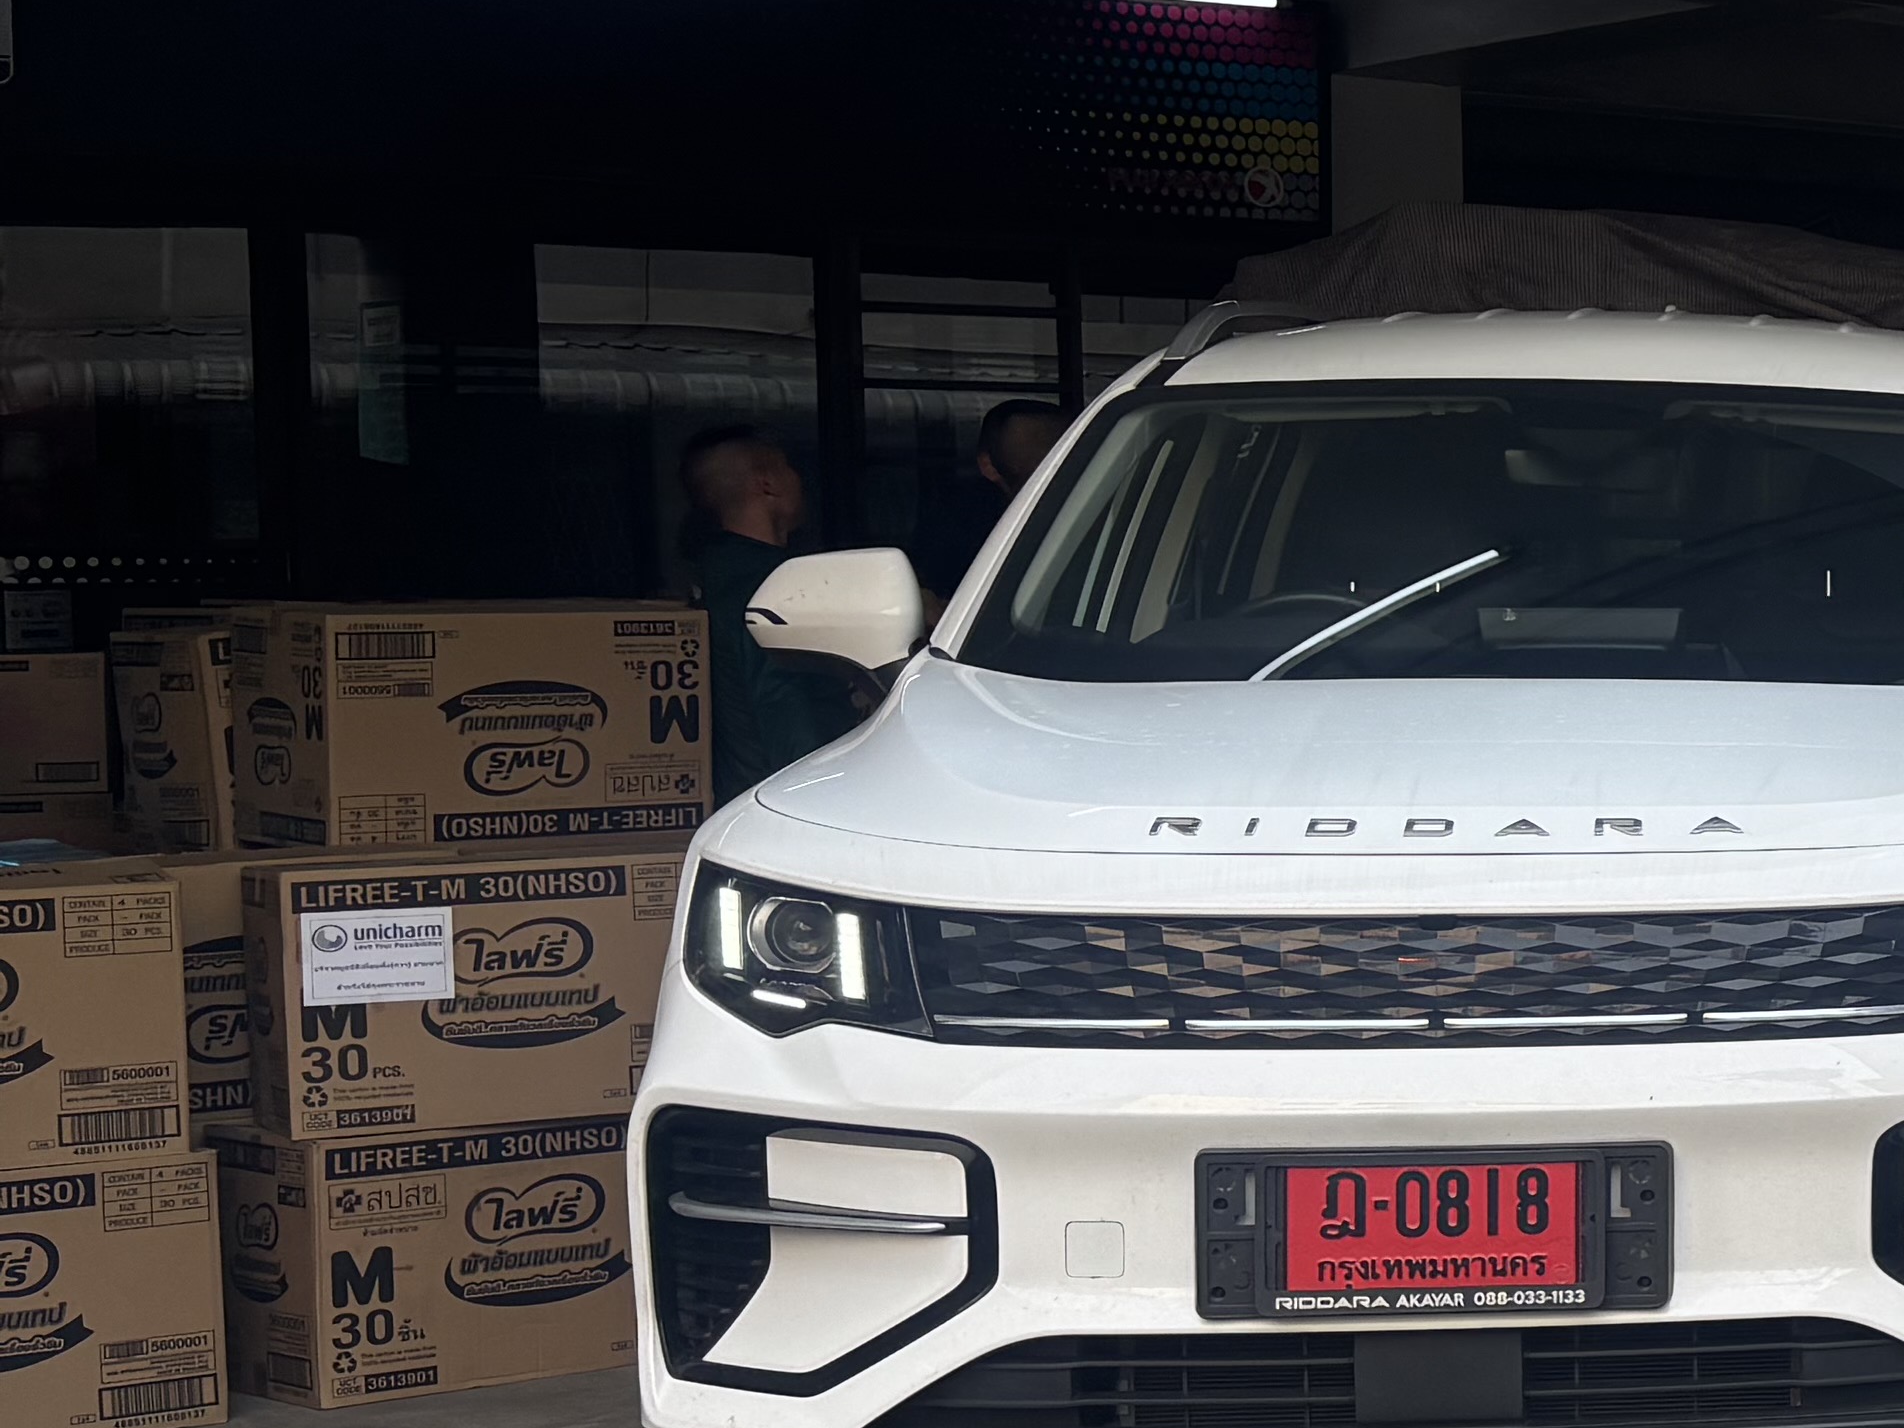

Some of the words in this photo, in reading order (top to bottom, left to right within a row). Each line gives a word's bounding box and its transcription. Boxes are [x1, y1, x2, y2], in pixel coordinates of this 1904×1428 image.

[651, 660, 700, 690] 30
[650, 694, 699, 744] M
[1148, 814, 1745, 838] RIDDARA
[301, 878, 467, 908] LIFREE-T-M
[479, 869, 618, 902] 30(NHSO)
[353, 922, 444, 942] unicharm
[111, 1065, 171, 1081] 5600001
[301, 1043, 369, 1084] 30
[373, 1065, 406, 1079] PCS.
[333, 1139, 489, 1174] LIFREE-T-M
[501, 1124, 626, 1158] 30(NHSO)
[331, 1246, 394, 1308] M
[1316, 1253, 1548, 1290] กรุงเทพมหานคร
[1275, 1294, 1390, 1311] RIDDARA
[1396, 1291, 1465, 1308] AKAYAR
[1473, 1289, 1586, 1307] 088-033-1133
[151, 1333, 209, 1353] 5600001
[332, 1308, 394, 1350] 30
